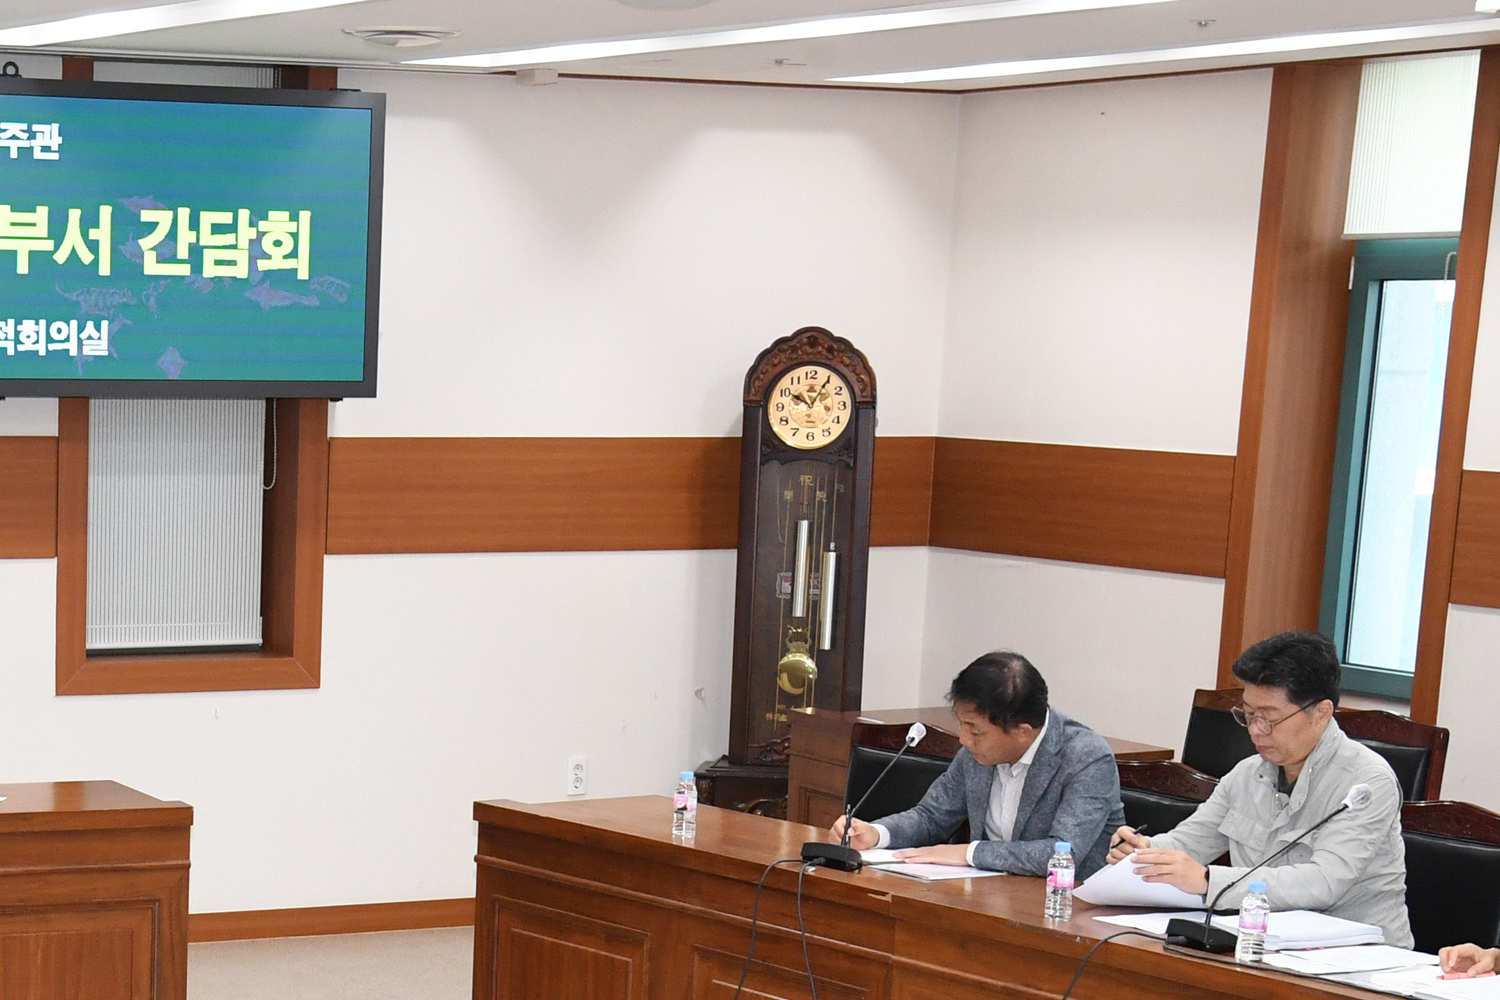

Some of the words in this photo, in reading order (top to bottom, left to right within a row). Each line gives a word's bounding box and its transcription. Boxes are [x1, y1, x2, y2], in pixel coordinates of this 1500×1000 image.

[138, 207, 311, 279] 간담회
[805, 370, 818, 380] 12
[790, 376, 800, 385] 11
[780, 387, 791, 397] 10
[834, 386, 843, 395] 2
[776, 402, 785, 412] 9
[838, 401, 847, 410] 3
[780, 416, 789, 426] 8
[831, 415, 840, 424] 4
[790, 427, 800, 437] 7
[806, 432, 815, 441] 6
[821, 427, 832, 437] 5
